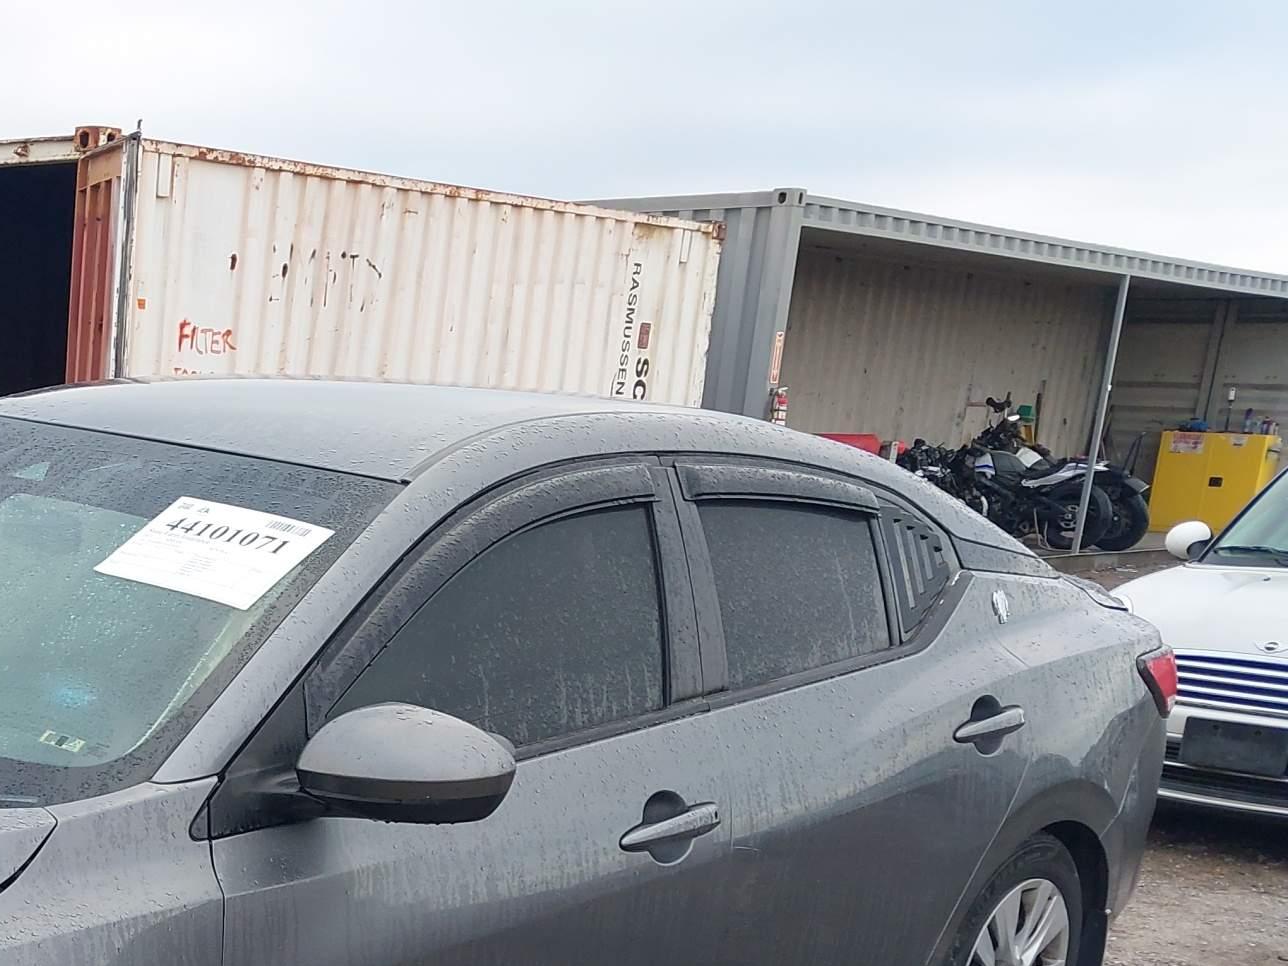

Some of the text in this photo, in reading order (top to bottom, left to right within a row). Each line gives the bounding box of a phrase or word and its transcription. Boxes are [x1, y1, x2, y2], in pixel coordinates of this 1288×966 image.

[178, 319, 237, 355] FILTER
[615, 262, 643, 396] RASMUSSEN
[165, 517, 291, 554] 44101071
